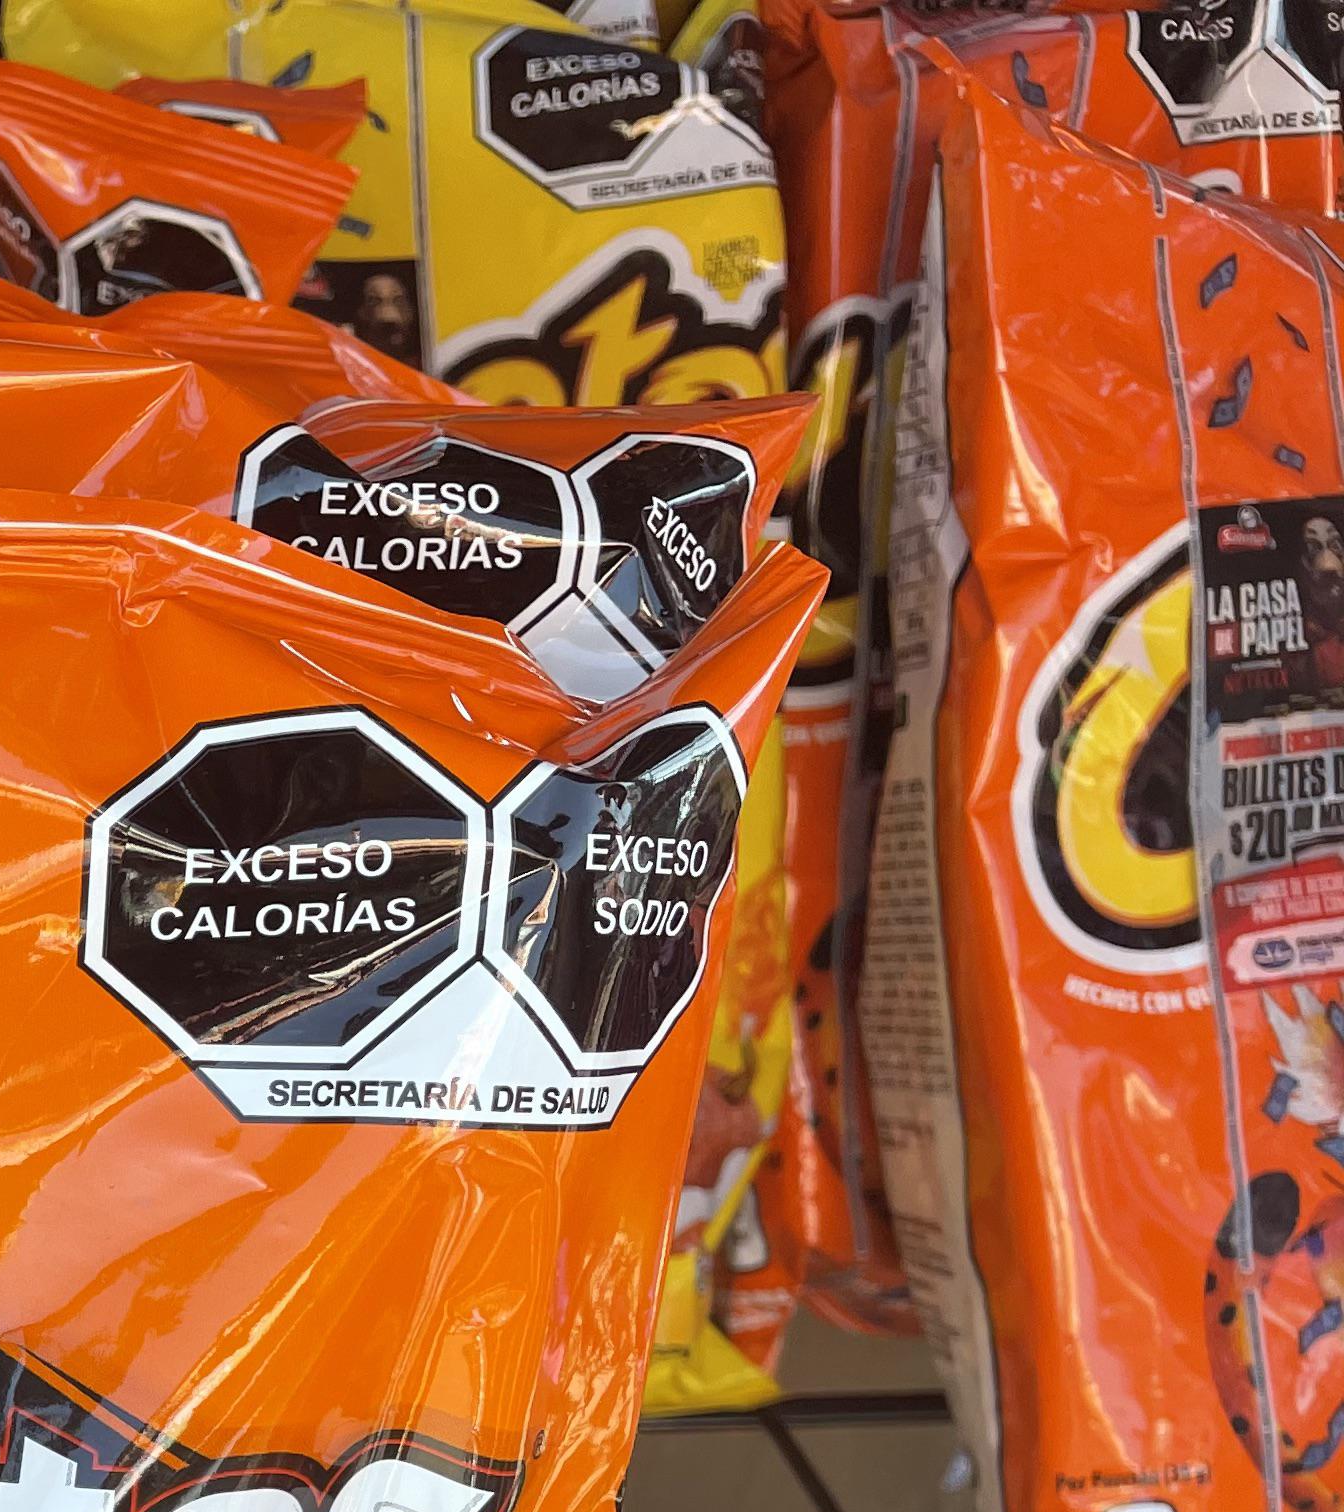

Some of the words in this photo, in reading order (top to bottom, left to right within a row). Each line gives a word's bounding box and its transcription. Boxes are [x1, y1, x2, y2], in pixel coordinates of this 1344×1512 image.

[525, 51, 642, 82] EXCESO
[510, 71, 662, 118] CALORÍAS
[1273, 112, 1298, 128] DE
[319, 481, 500, 517] EXCESO
[646, 496, 717, 592] EXCESO
[1239, 577, 1302, 621] CASA
[1241, 617, 1310, 657] PAPEL
[1223, 755, 1327, 809] BILLETES
[184, 839, 392, 887] EXCESO
[585, 833, 709, 879] EXCESO
[150, 892, 416, 940] CALORÍAS
[593, 898, 689, 938] SODIO
[268, 1077, 482, 1112] SECRETARÍA
[490, 1082, 533, 1115] DE
[540, 1086, 610, 1116] SALUD
